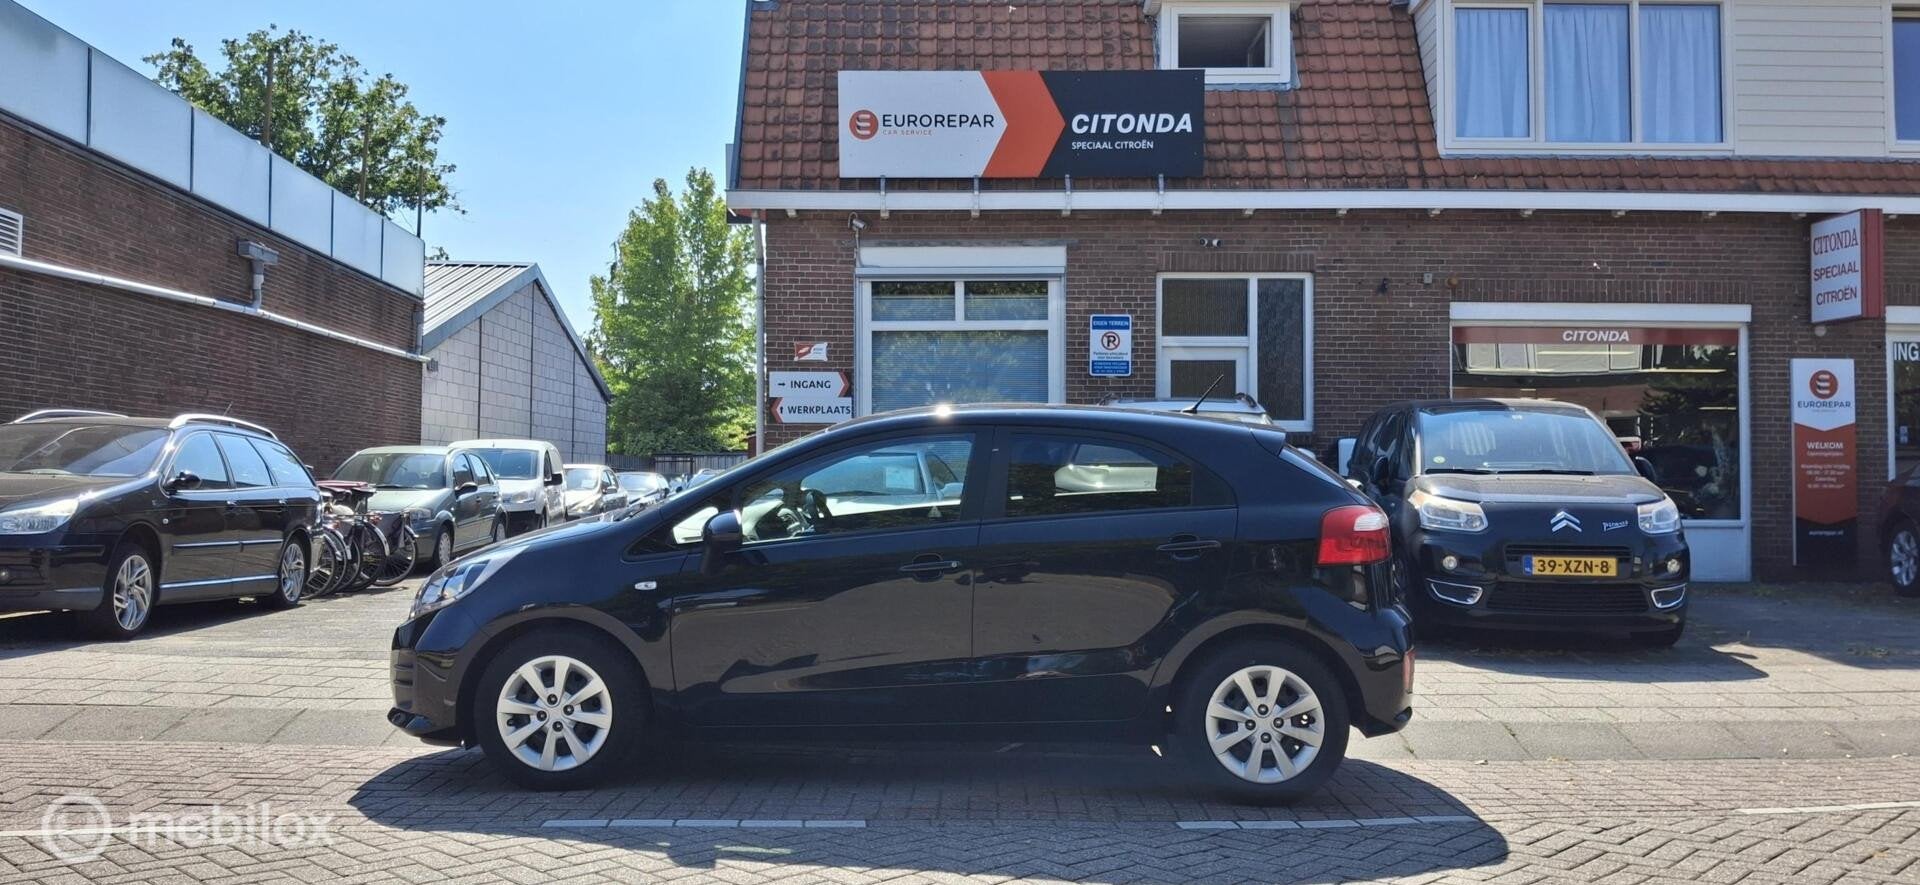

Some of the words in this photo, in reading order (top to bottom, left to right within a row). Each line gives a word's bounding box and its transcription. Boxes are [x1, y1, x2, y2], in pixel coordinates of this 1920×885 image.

[882, 114, 994, 128] EUROREPAR
[1071, 113, 1192, 134] CITONDA
[1071, 141, 1113, 150] SPECIAAL
[1114, 140, 1154, 149] CITROËN
[1813, 228, 1859, 255] CITONDA
[1813, 261, 1859, 282] SPECIAAL
[1816, 285, 1857, 306] CITROËN
[1562, 330, 1630, 342] CITONDA
[790, 380, 831, 389] INGANG
[787, 406, 851, 415] WERKPLAATS
[1797, 400, 1851, 409] EUROREPAR
[1806, 441, 1844, 449] WELKOM
[1537, 559, 1609, 574] 39-XZN-8
